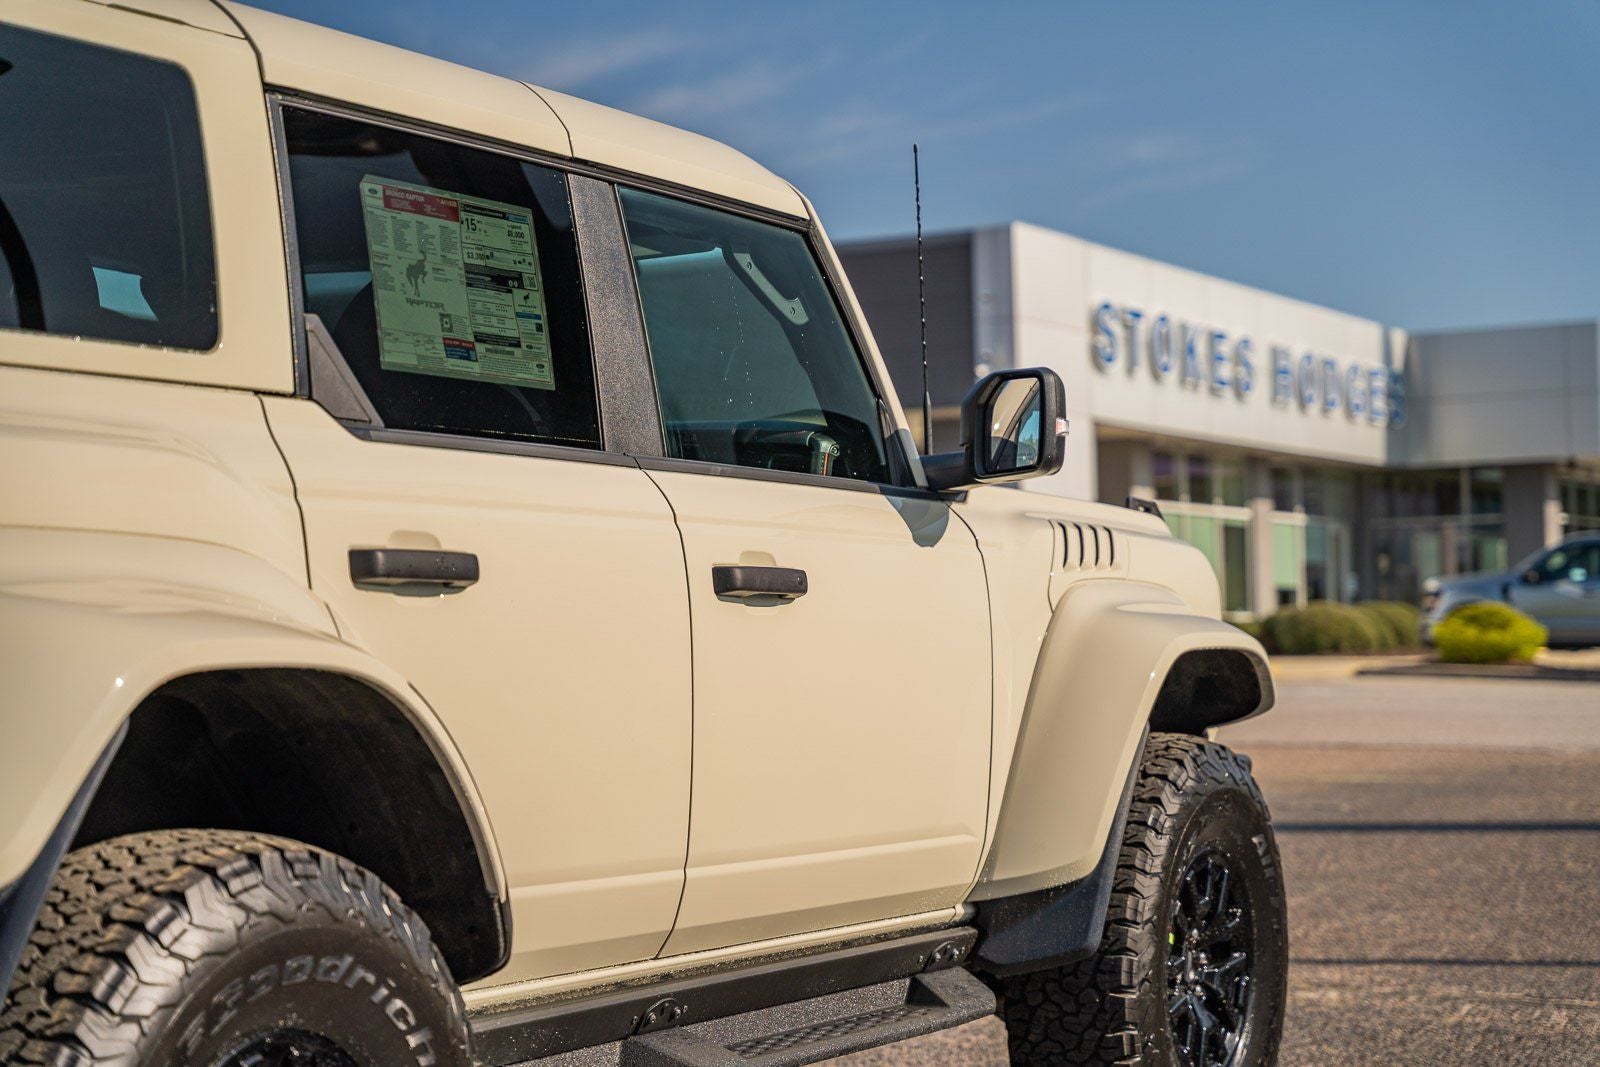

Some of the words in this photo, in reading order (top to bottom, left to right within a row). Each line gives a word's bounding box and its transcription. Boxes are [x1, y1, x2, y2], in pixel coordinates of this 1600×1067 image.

[465, 217, 477, 232] 15
[405, 297, 447, 311] RAPTOR
[1091, 301, 1256, 399] STOKES
[1270, 344, 1408, 428] HODGES
